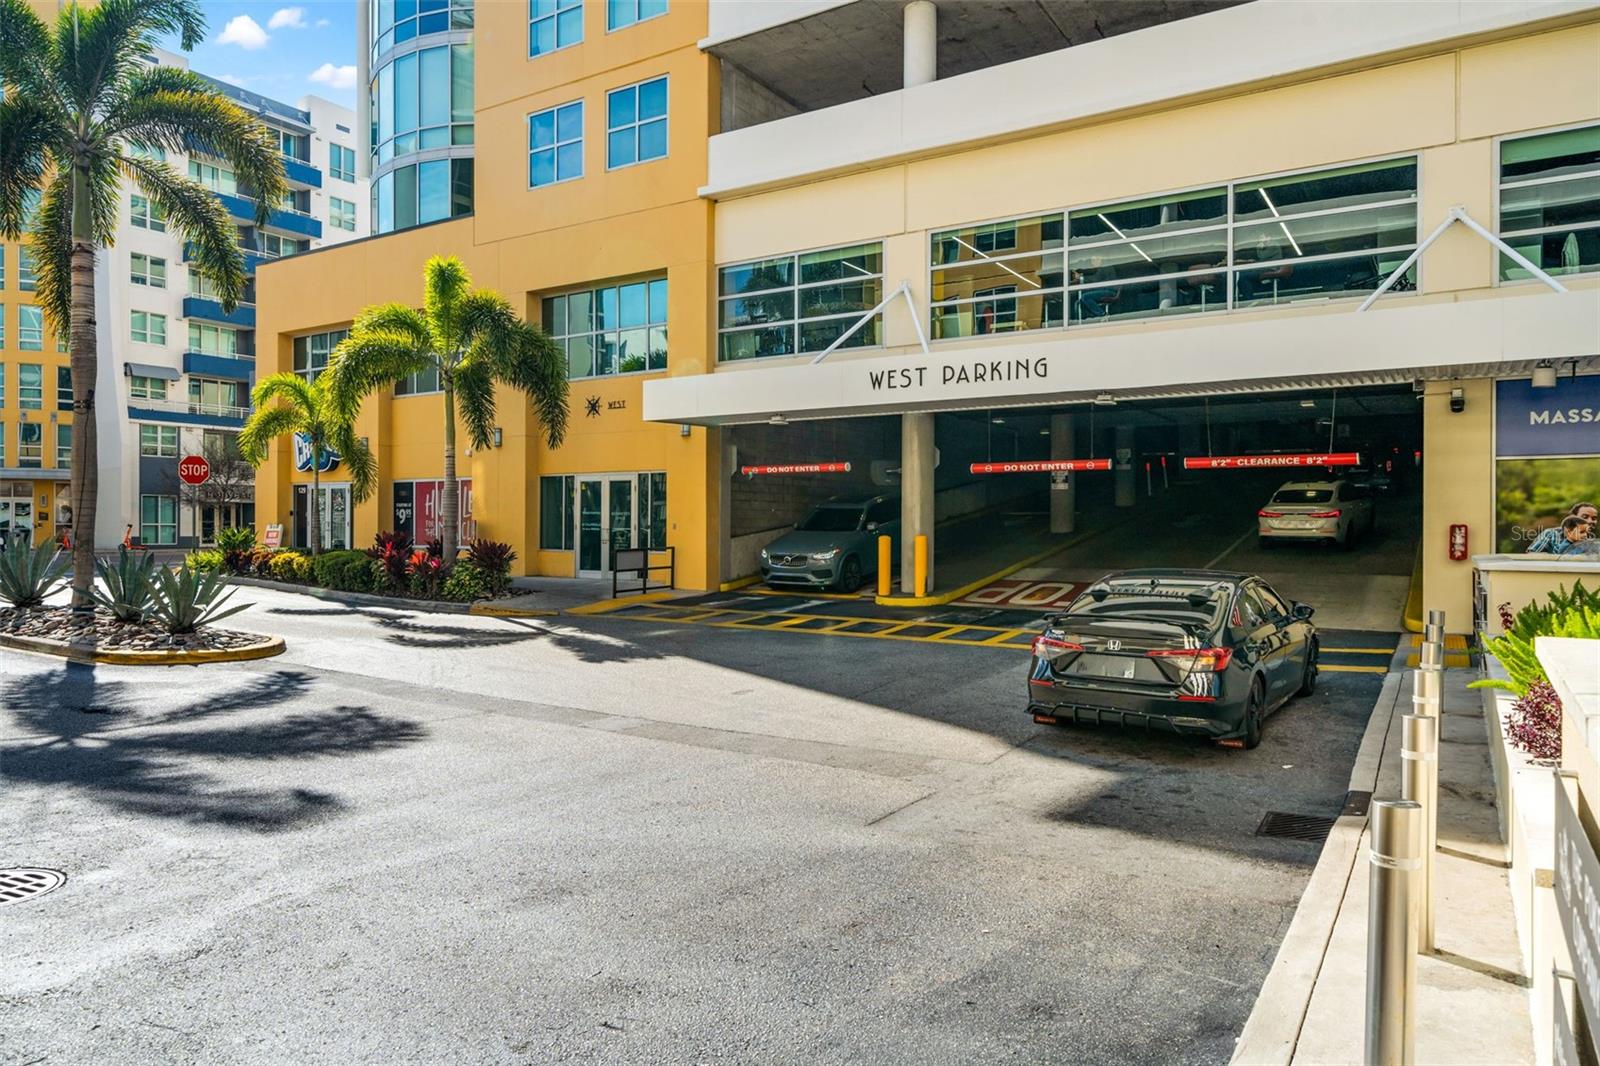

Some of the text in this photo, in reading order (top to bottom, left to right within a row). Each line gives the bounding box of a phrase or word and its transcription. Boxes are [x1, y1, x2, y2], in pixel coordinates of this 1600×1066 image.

[869, 357, 1048, 390] WEST PARKING
[607, 400, 626, 409] WEST
[1237, 457, 1300, 466] CLEARANCE
[181, 464, 208, 476] STOP
[795, 465, 820, 473] ENTER
[1004, 462, 1074, 472] DO NOT ENTER
